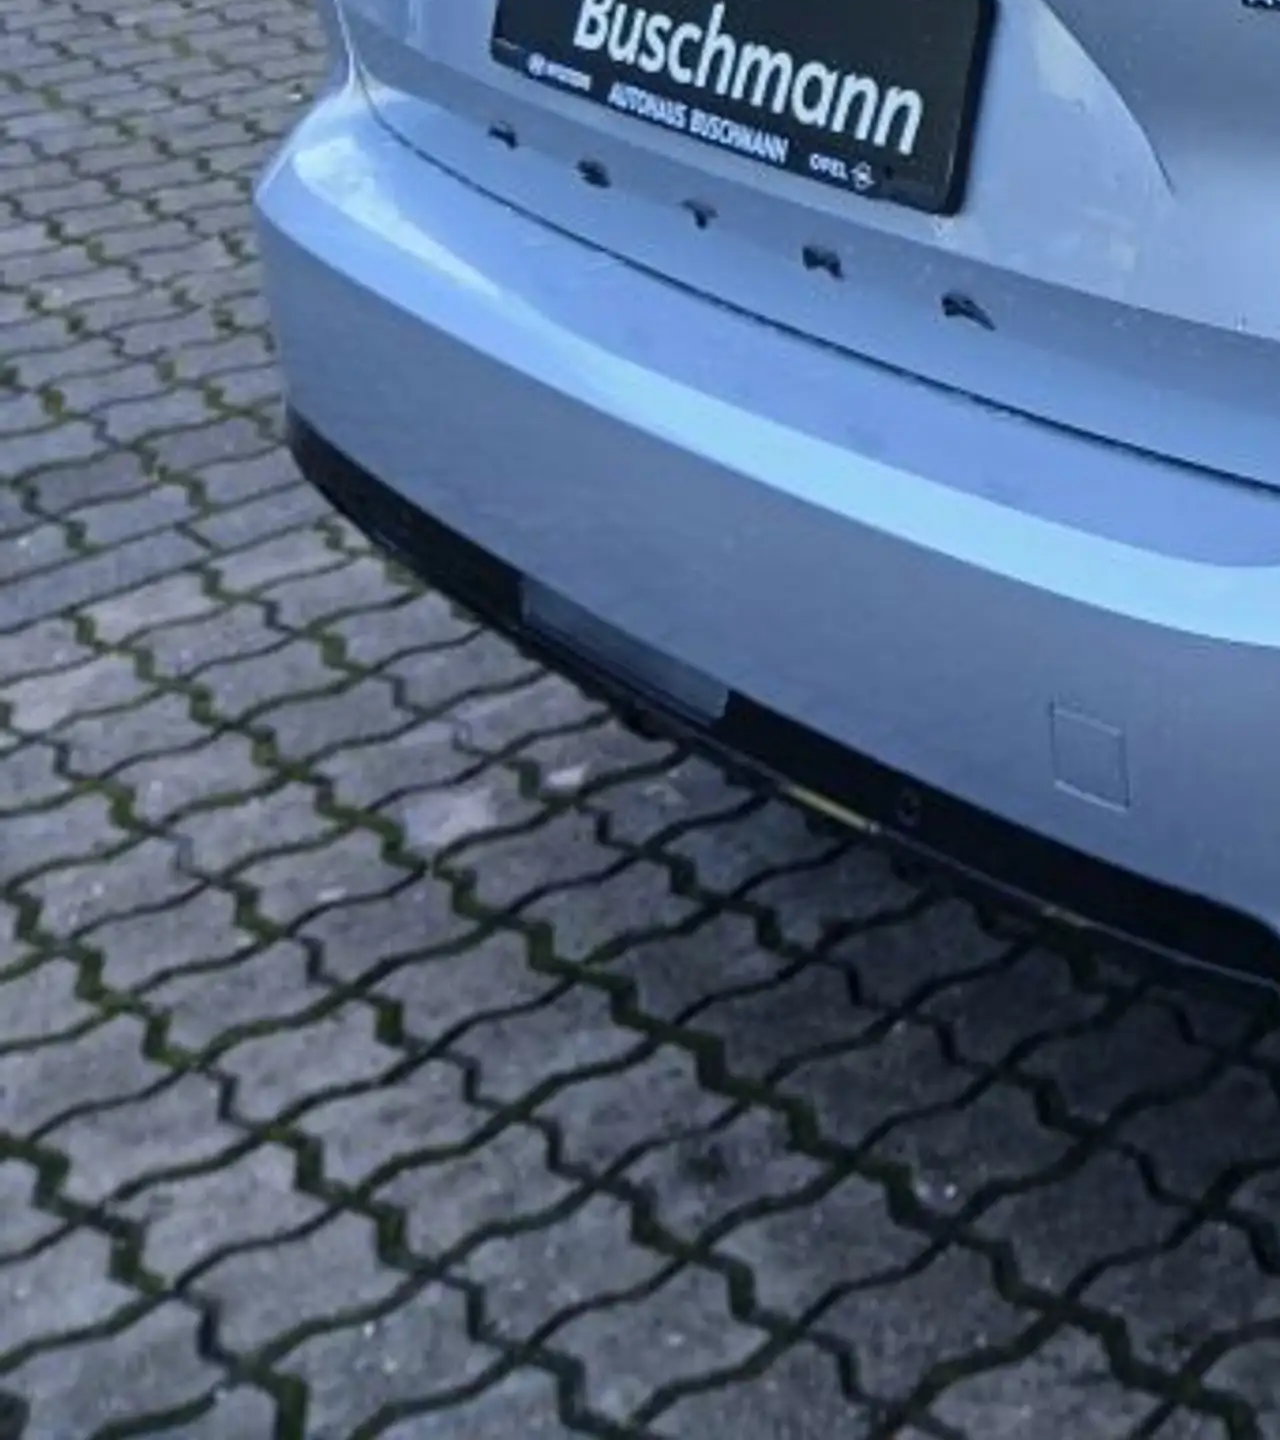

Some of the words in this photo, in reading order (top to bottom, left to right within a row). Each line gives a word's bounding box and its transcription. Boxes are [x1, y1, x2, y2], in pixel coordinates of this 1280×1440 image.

[608, 81, 688, 129] AUTOHAUS
[689, 107, 790, 164] BUSCHMANN
[809, 152, 849, 181] OPEL
